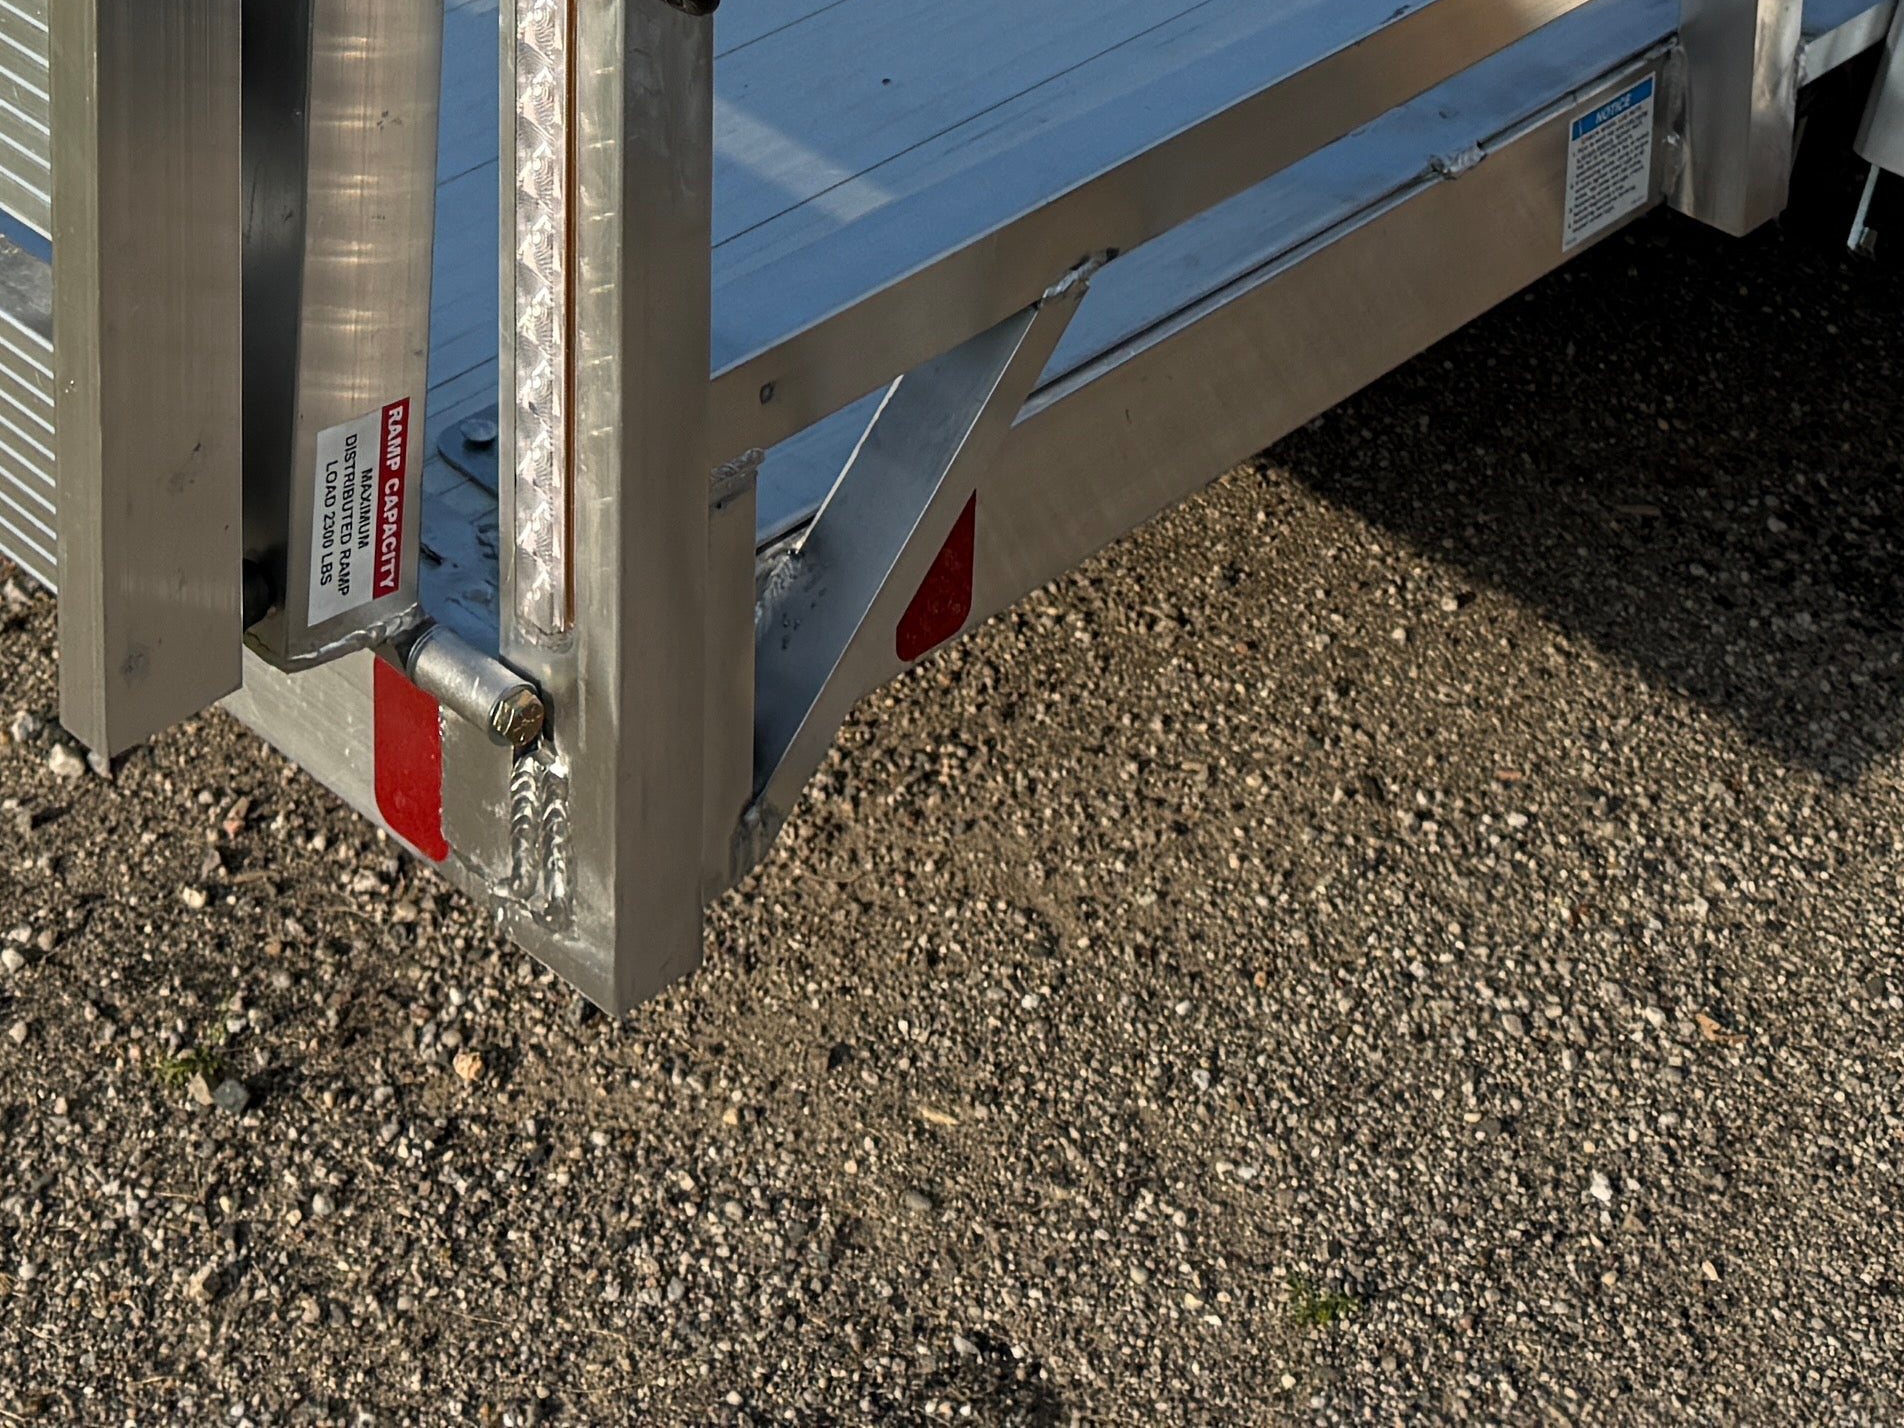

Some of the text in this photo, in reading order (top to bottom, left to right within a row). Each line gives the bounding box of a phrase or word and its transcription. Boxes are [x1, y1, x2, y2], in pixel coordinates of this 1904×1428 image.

[1595, 93, 1633, 124] NOTICE
[320, 459, 339, 587] LOAD 2300 LBS
[338, 433, 358, 597] DISTRIBUTED RAMP
[357, 467, 374, 550] MAXIMUM
[379, 405, 404, 588] RAMP CAPACITY
